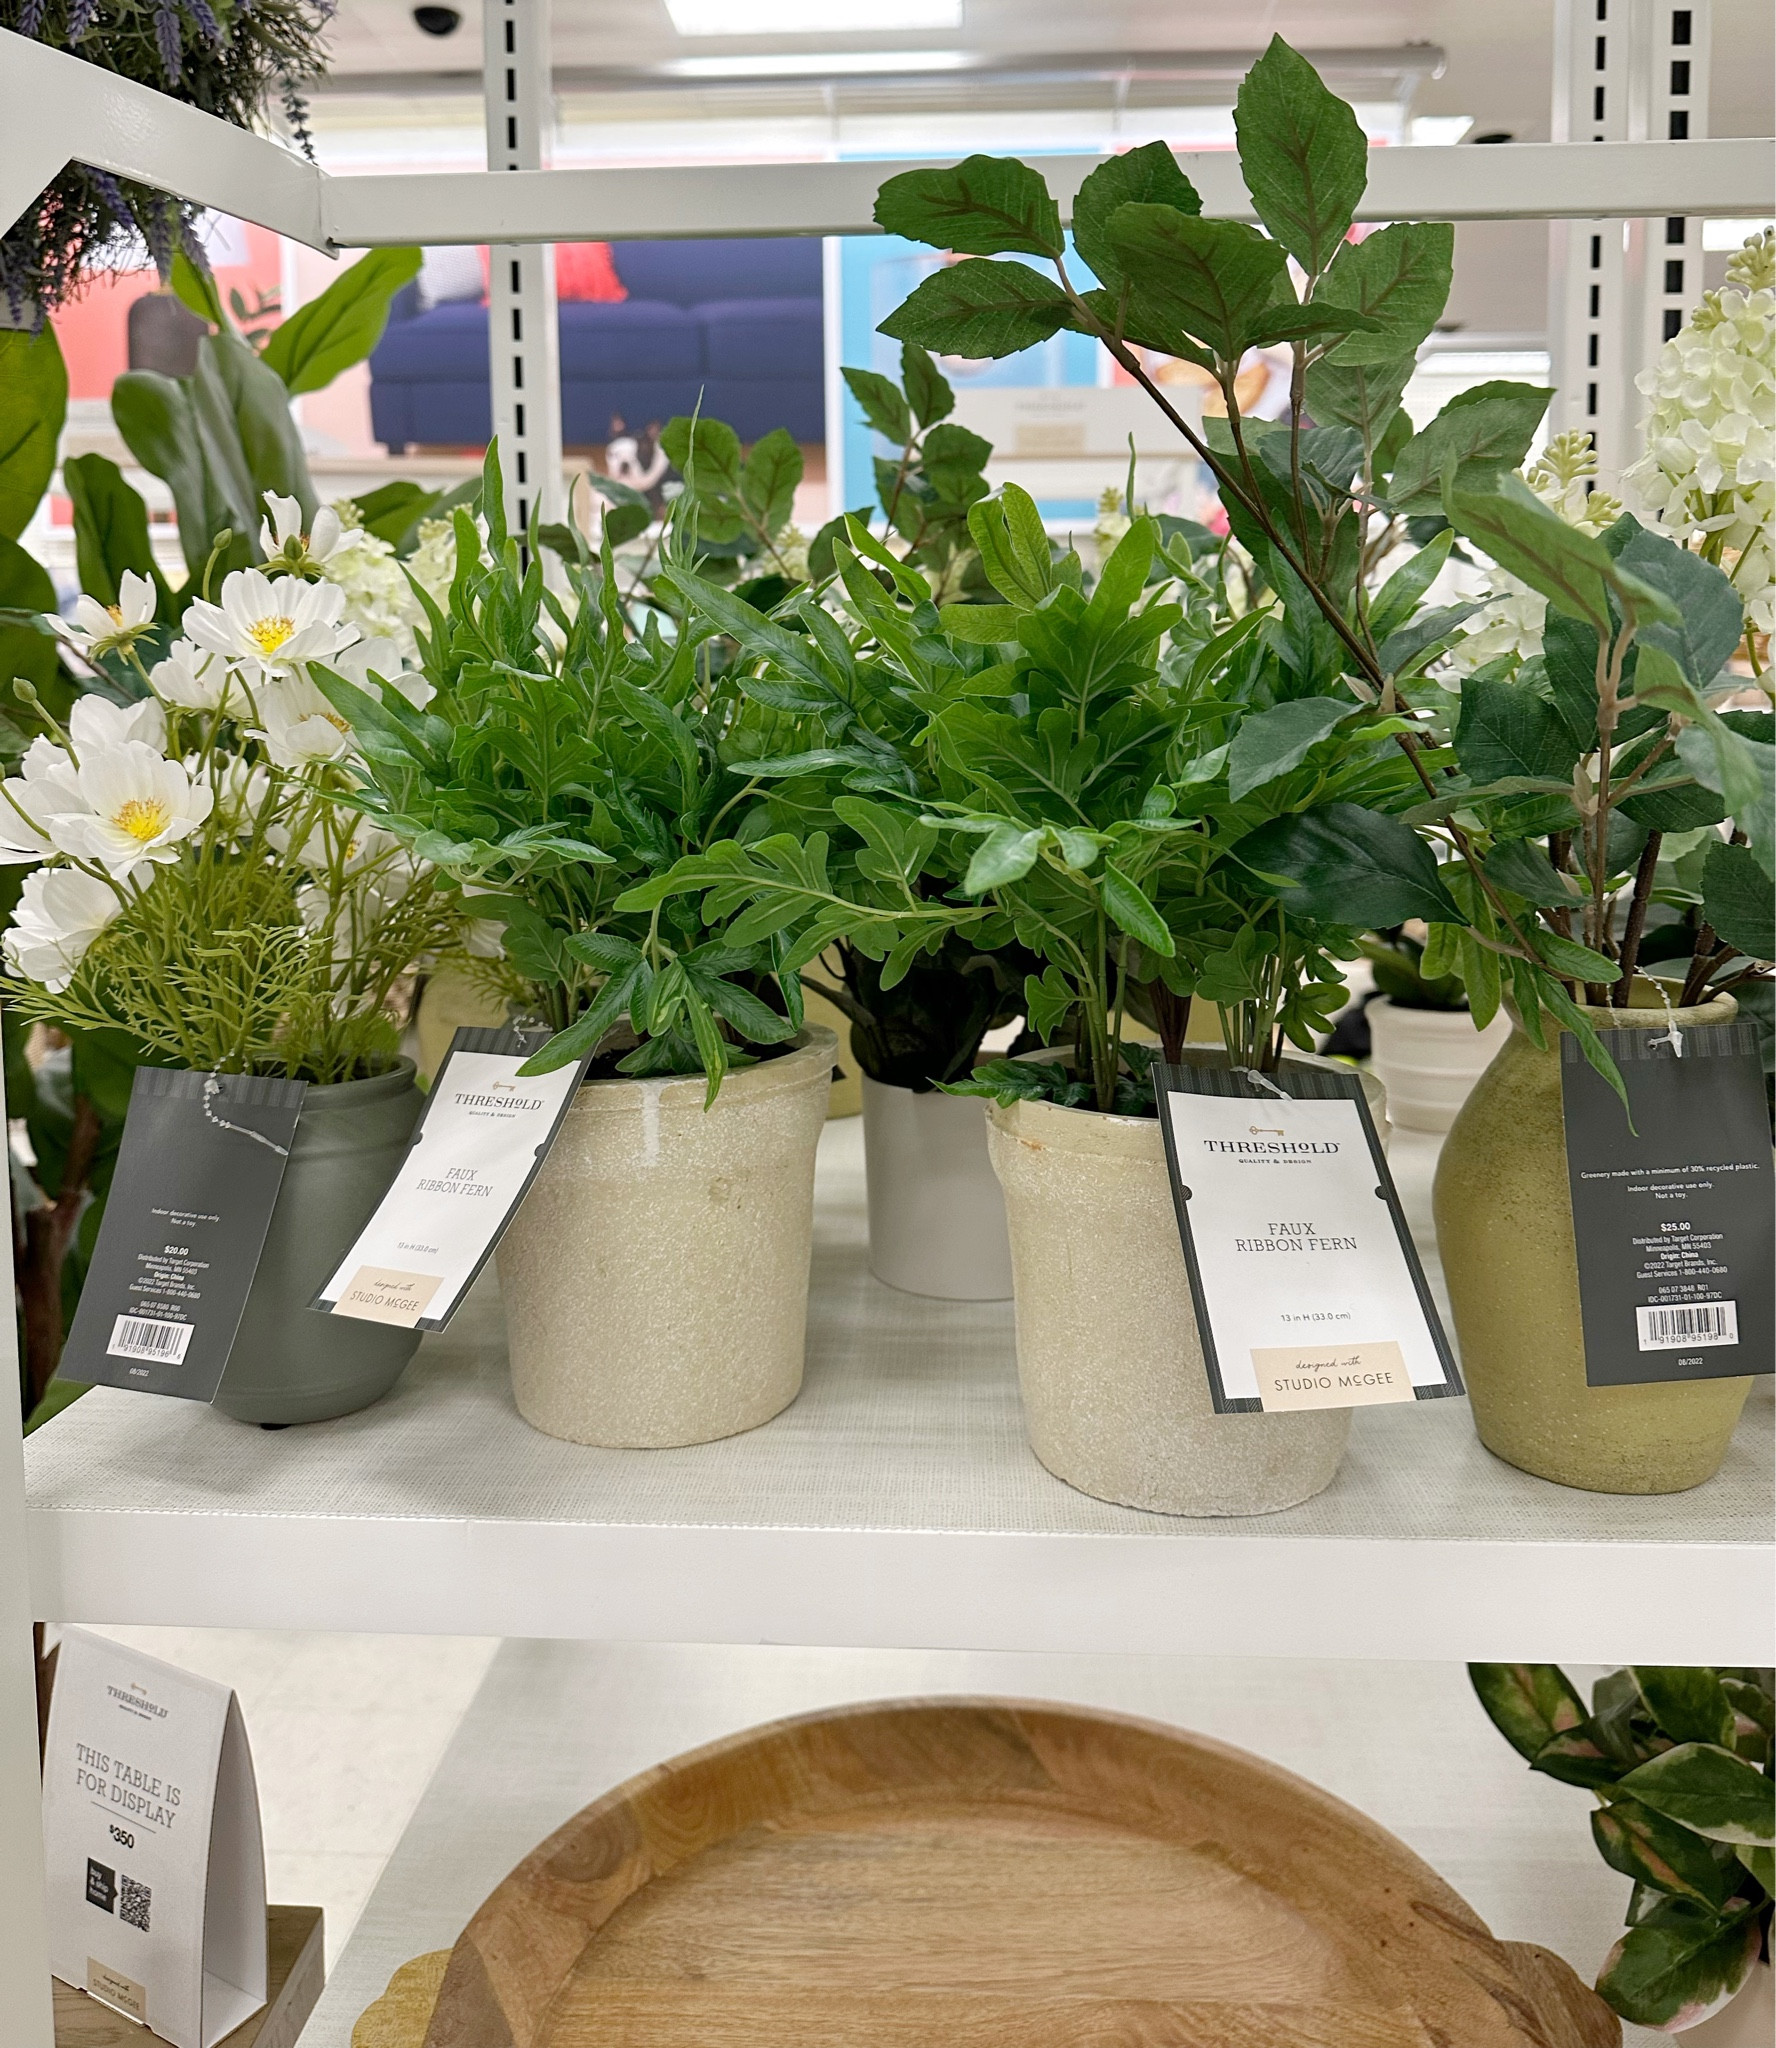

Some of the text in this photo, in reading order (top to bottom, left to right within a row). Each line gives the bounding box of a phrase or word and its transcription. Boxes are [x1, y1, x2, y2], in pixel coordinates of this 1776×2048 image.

[445, 1168, 478, 1181] FAUX
[1581, 1171, 1610, 1180] Greenery
[1611, 1169, 1630, 1178] made
[1631, 1168, 1645, 1176] with
[1651, 1167, 1681, 1175] minimum
[1690, 1165, 1705, 1173] 30%
[1706, 1163, 1734, 1173] recycled
[1735, 1162, 1761, 1172] plastic.
[416, 1178, 494, 1197] RIBBON FERN
[1650, 1183, 1684, 1191] decorative
[1698, 1181, 1715, 1190] only.
[1674, 1192, 1688, 1200] toy.
[1267, 1222, 1316, 1235] FAUX
[1660, 1222, 1691, 1232] $25.00
[1235, 1237, 1358, 1252] RIBBON FERN
[1632, 1233, 1723, 1245] Distributed by Target Corporation
[164, 1245, 189, 1255] $20.00
[1646, 1244, 1681, 1252] Minneapolis,
[1660, 1251, 1699, 1260] Origin: China
[1684, 1259, 1706, 1267] Brands,
[1706, 1258, 1718, 1266] Inc.
[1653, 1269, 1678, 1277] Services
[1678, 1266, 1728, 1275] 1-800-440-0680
[374, 1278, 416, 1291] designed with
[350, 1290, 384, 1305] STUDIO
[1335, 1312, 1351, 1320] cm)
[1659, 1335, 1687, 1344] 91908
[1691, 1333, 1719, 1341] 95198
[124, 1345, 145, 1354] 91908
[148, 1348, 170, 1358] 95196
[1295, 1355, 1361, 1372] designed with
[1678, 1357, 1703, 1366] 08/2022
[1274, 1377, 1331, 1391] STUDIO
[76, 1742, 181, 1806] THIS TABLE IS
[76, 1768, 176, 1829] FOR DISPLAY
[109, 1824, 135, 1849] $350
